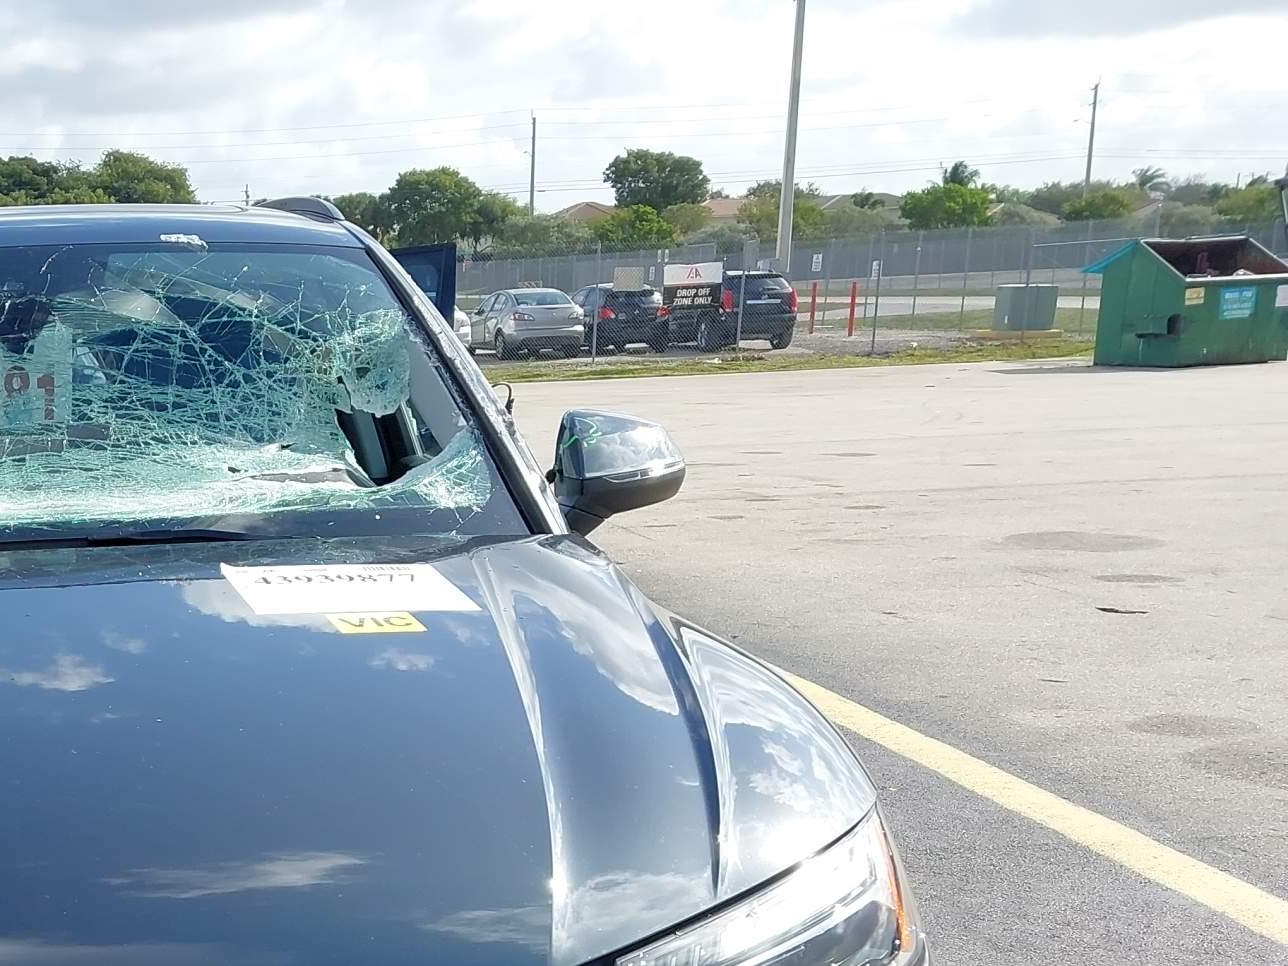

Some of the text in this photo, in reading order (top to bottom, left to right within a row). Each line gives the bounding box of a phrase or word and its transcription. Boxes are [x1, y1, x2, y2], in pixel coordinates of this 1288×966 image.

[677, 288, 711, 297] DROP OFF
[694, 296, 713, 305] ONLY
[338, 616, 414, 629] VIC
